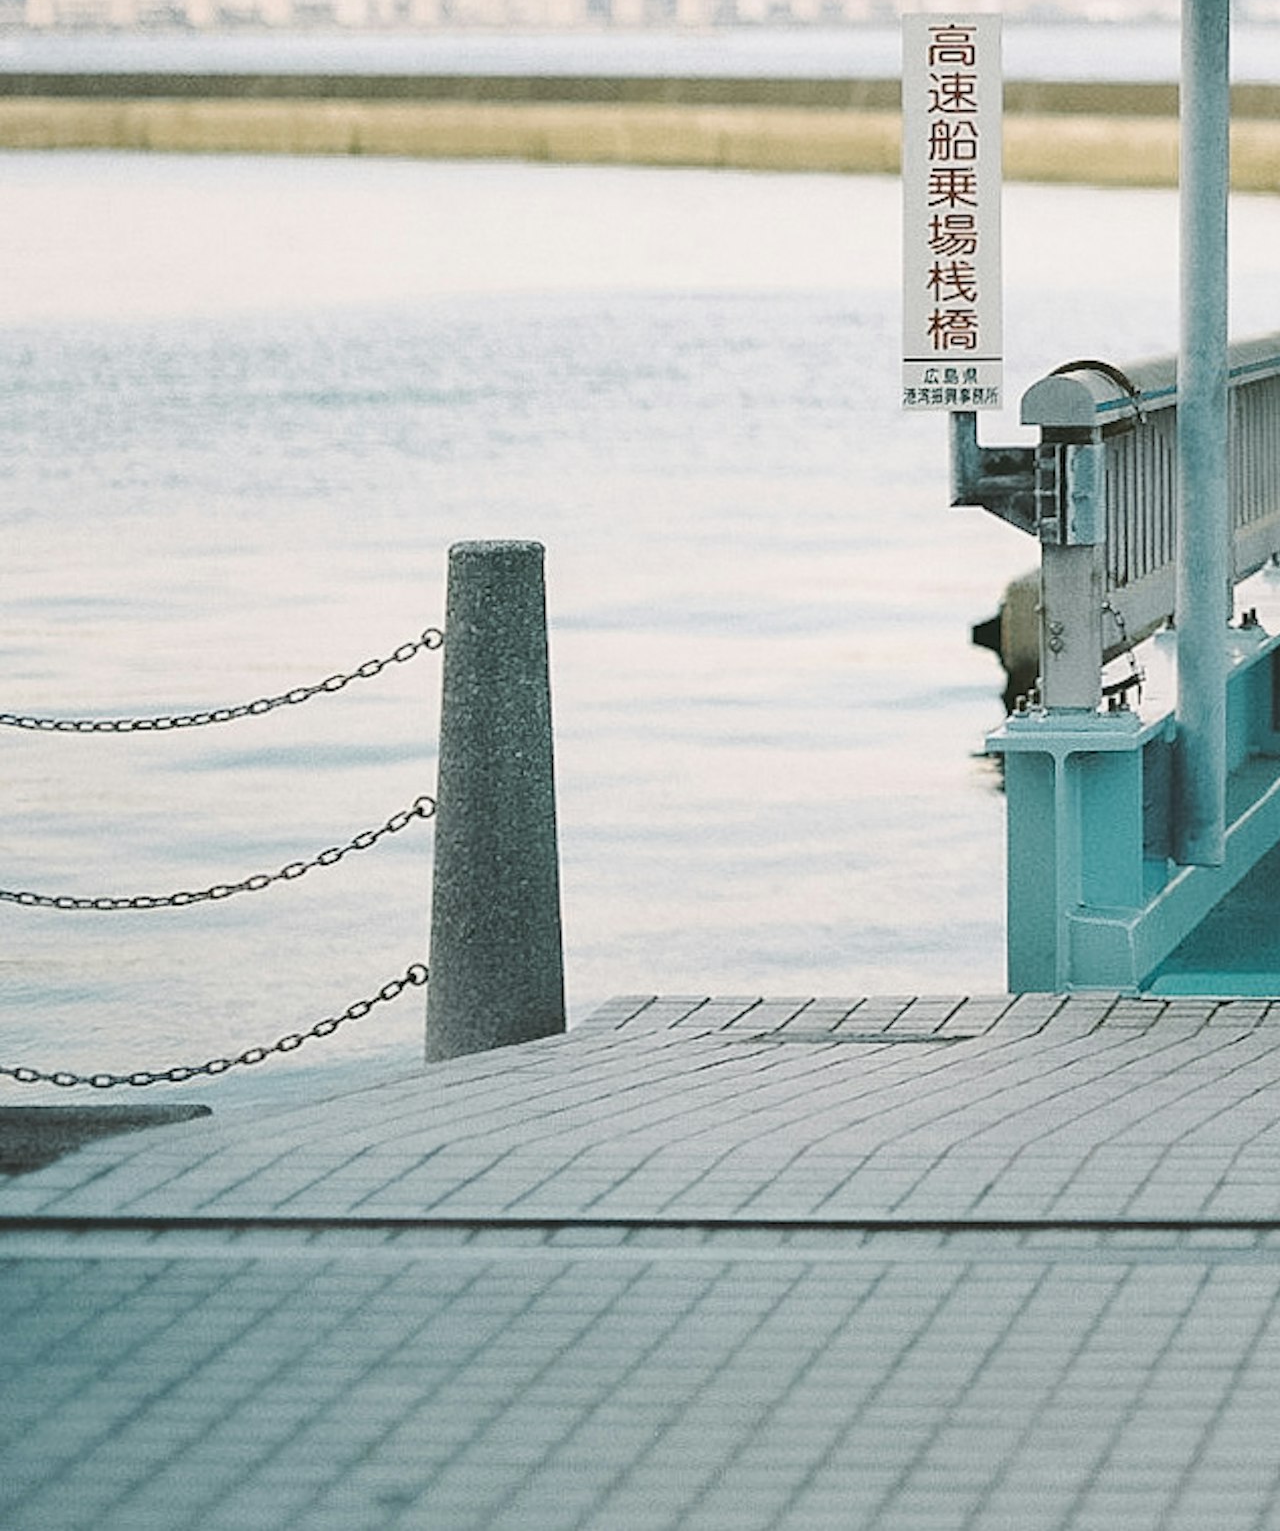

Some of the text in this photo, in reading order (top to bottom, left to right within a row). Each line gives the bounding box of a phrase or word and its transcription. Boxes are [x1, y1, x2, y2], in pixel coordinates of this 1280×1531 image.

[927, 24, 978, 351] 高速船乗場桟橋
